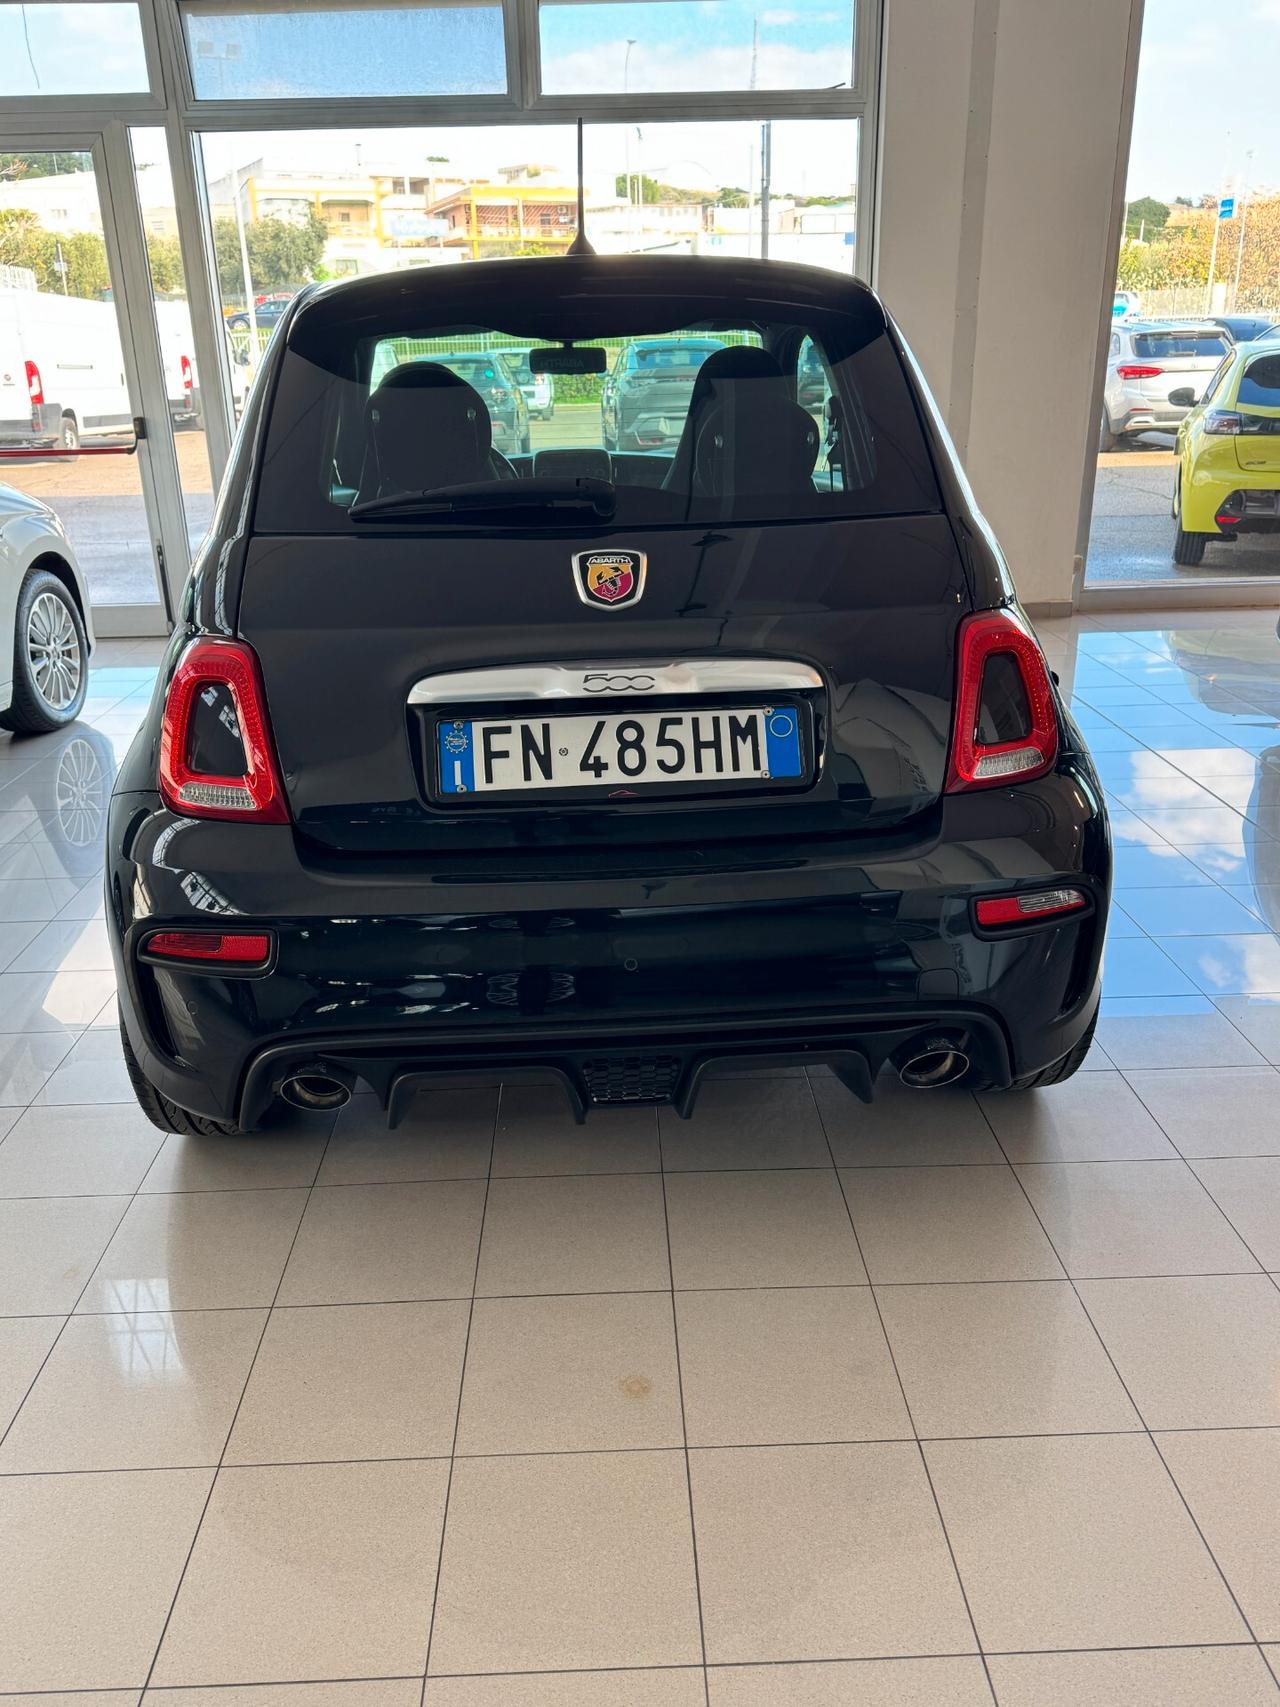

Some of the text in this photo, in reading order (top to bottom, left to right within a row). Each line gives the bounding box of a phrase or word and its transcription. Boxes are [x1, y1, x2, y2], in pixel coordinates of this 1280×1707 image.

[583, 674, 655, 692] 500
[483, 715, 761, 783] FN 485HM
